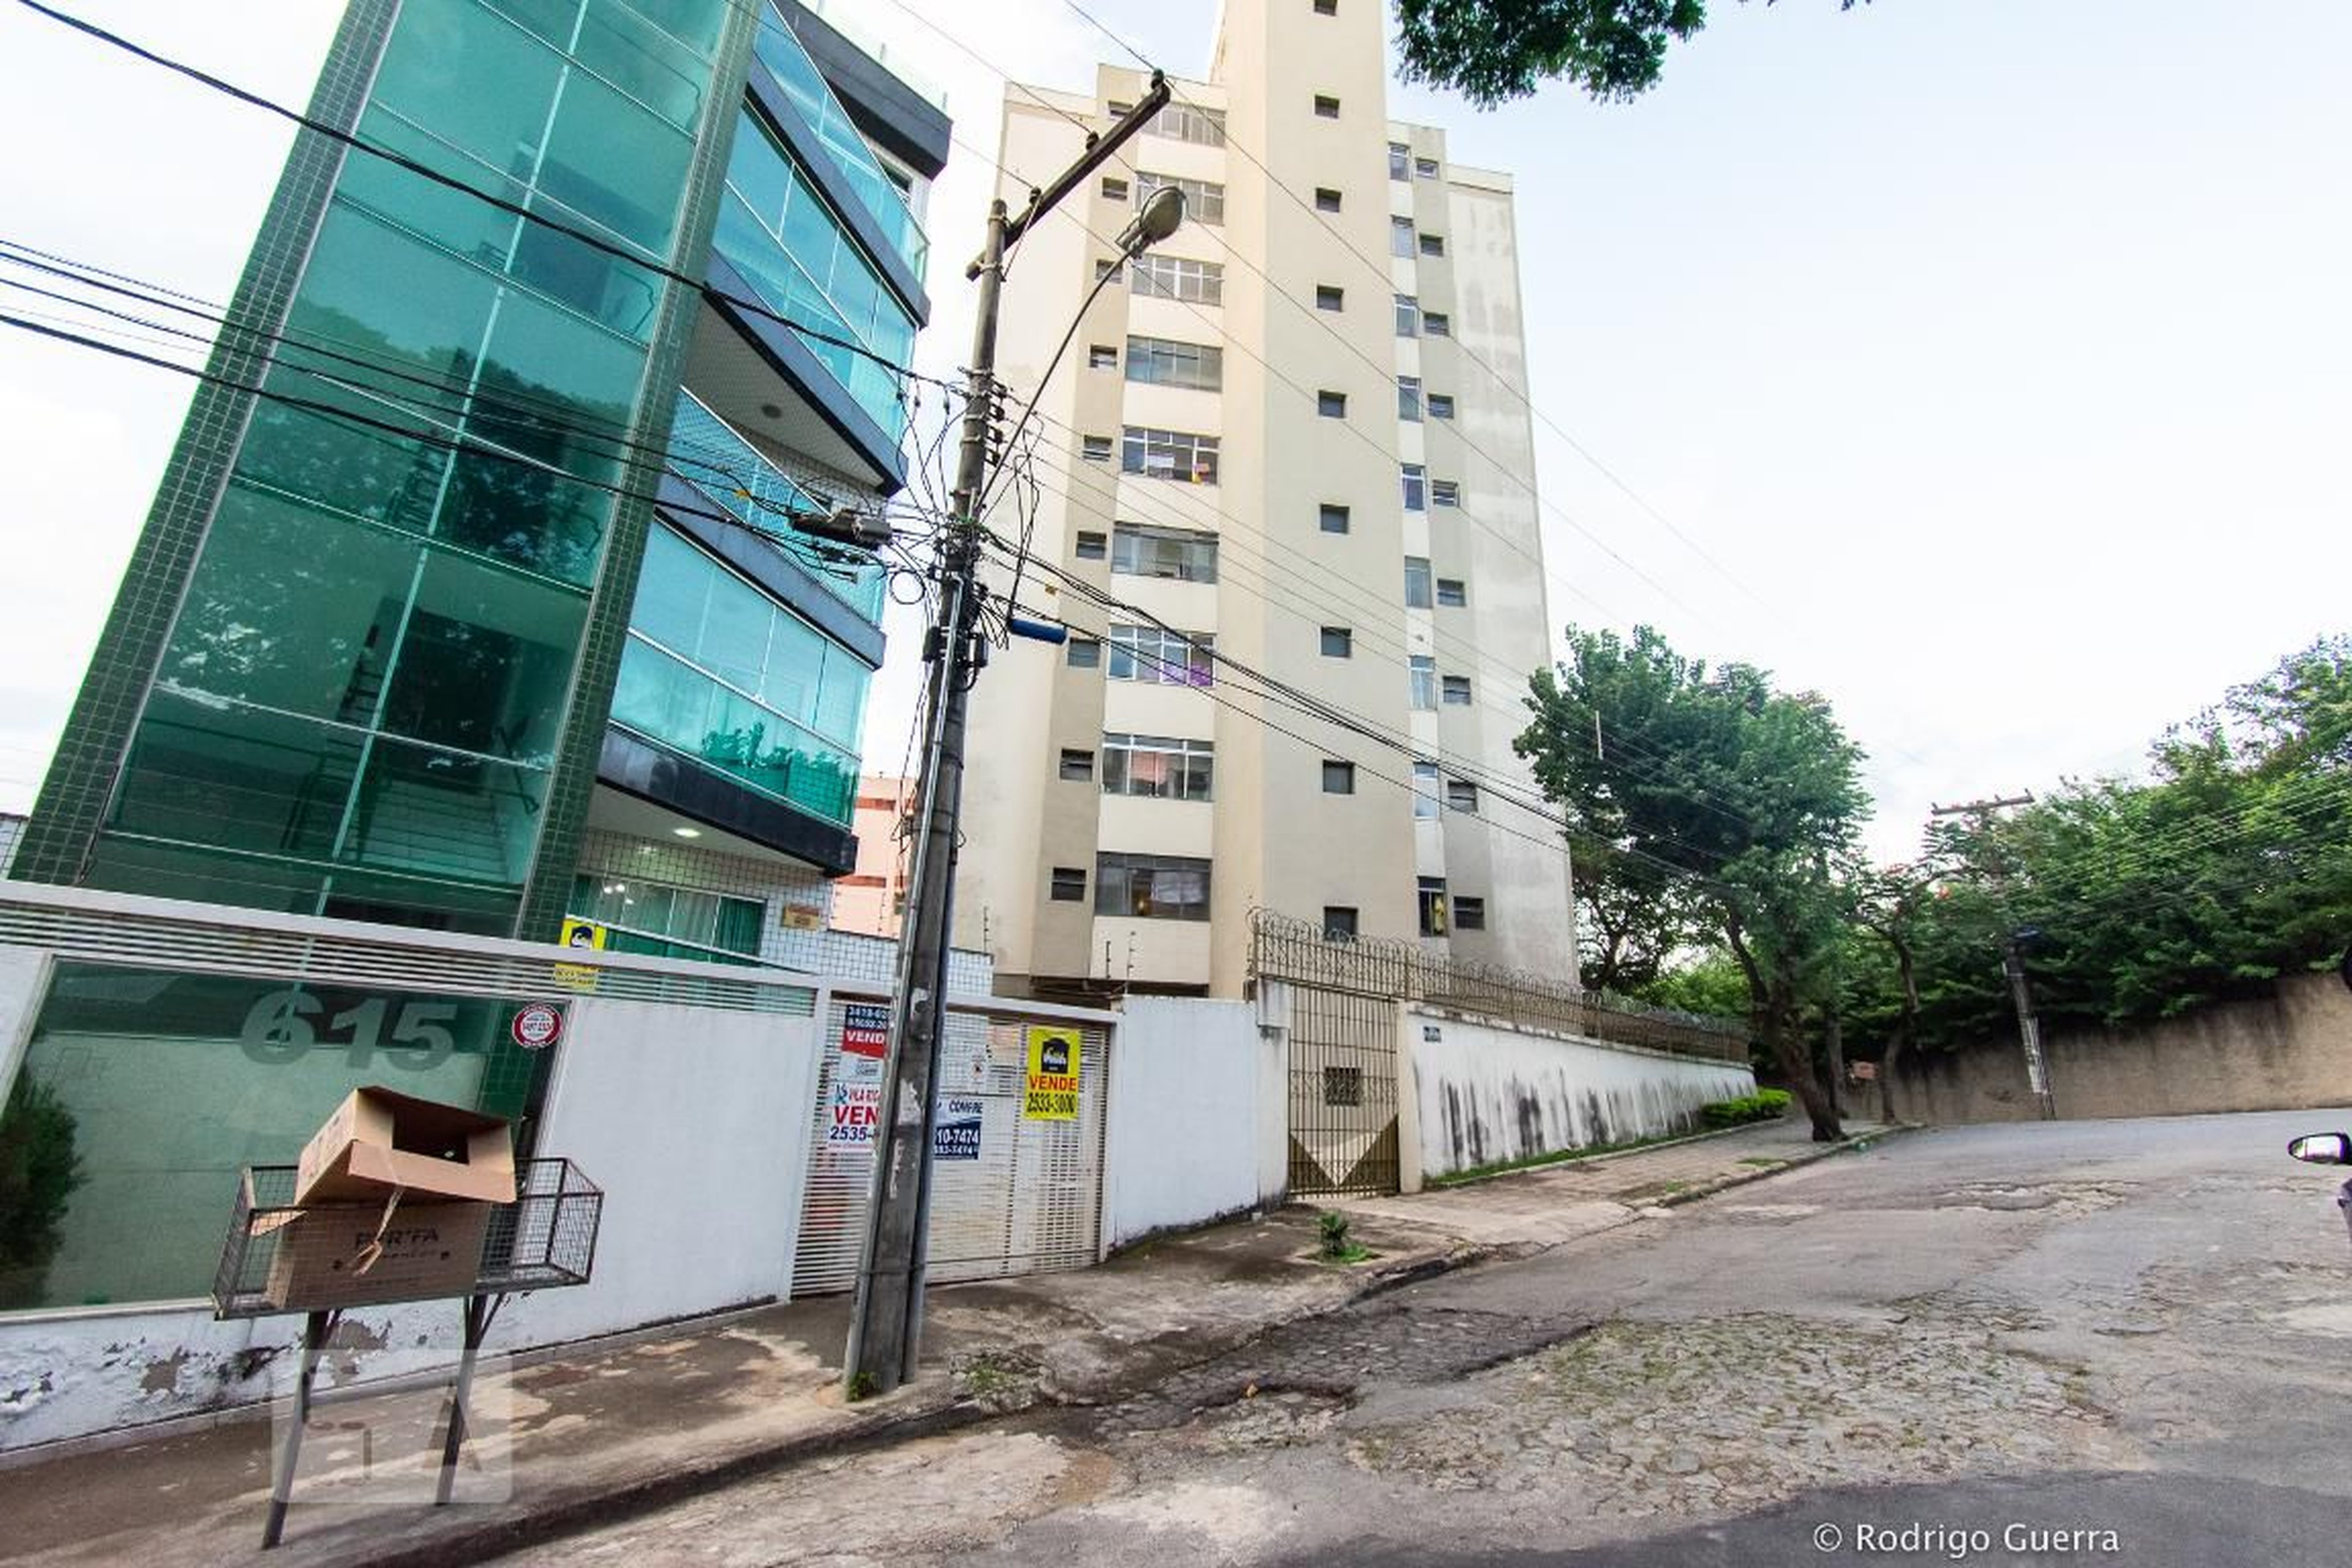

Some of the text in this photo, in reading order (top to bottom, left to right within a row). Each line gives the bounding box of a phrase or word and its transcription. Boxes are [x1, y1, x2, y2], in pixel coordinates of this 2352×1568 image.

[242, 990, 458, 1072] 615
[846, 1031, 885, 1044] VEND
[1029, 1075, 1077, 1091] VENDE
[835, 1106, 879, 1125] VEN
[831, 1126, 876, 1141] 2535-
[937, 1128, 979, 1144] 10-7474
